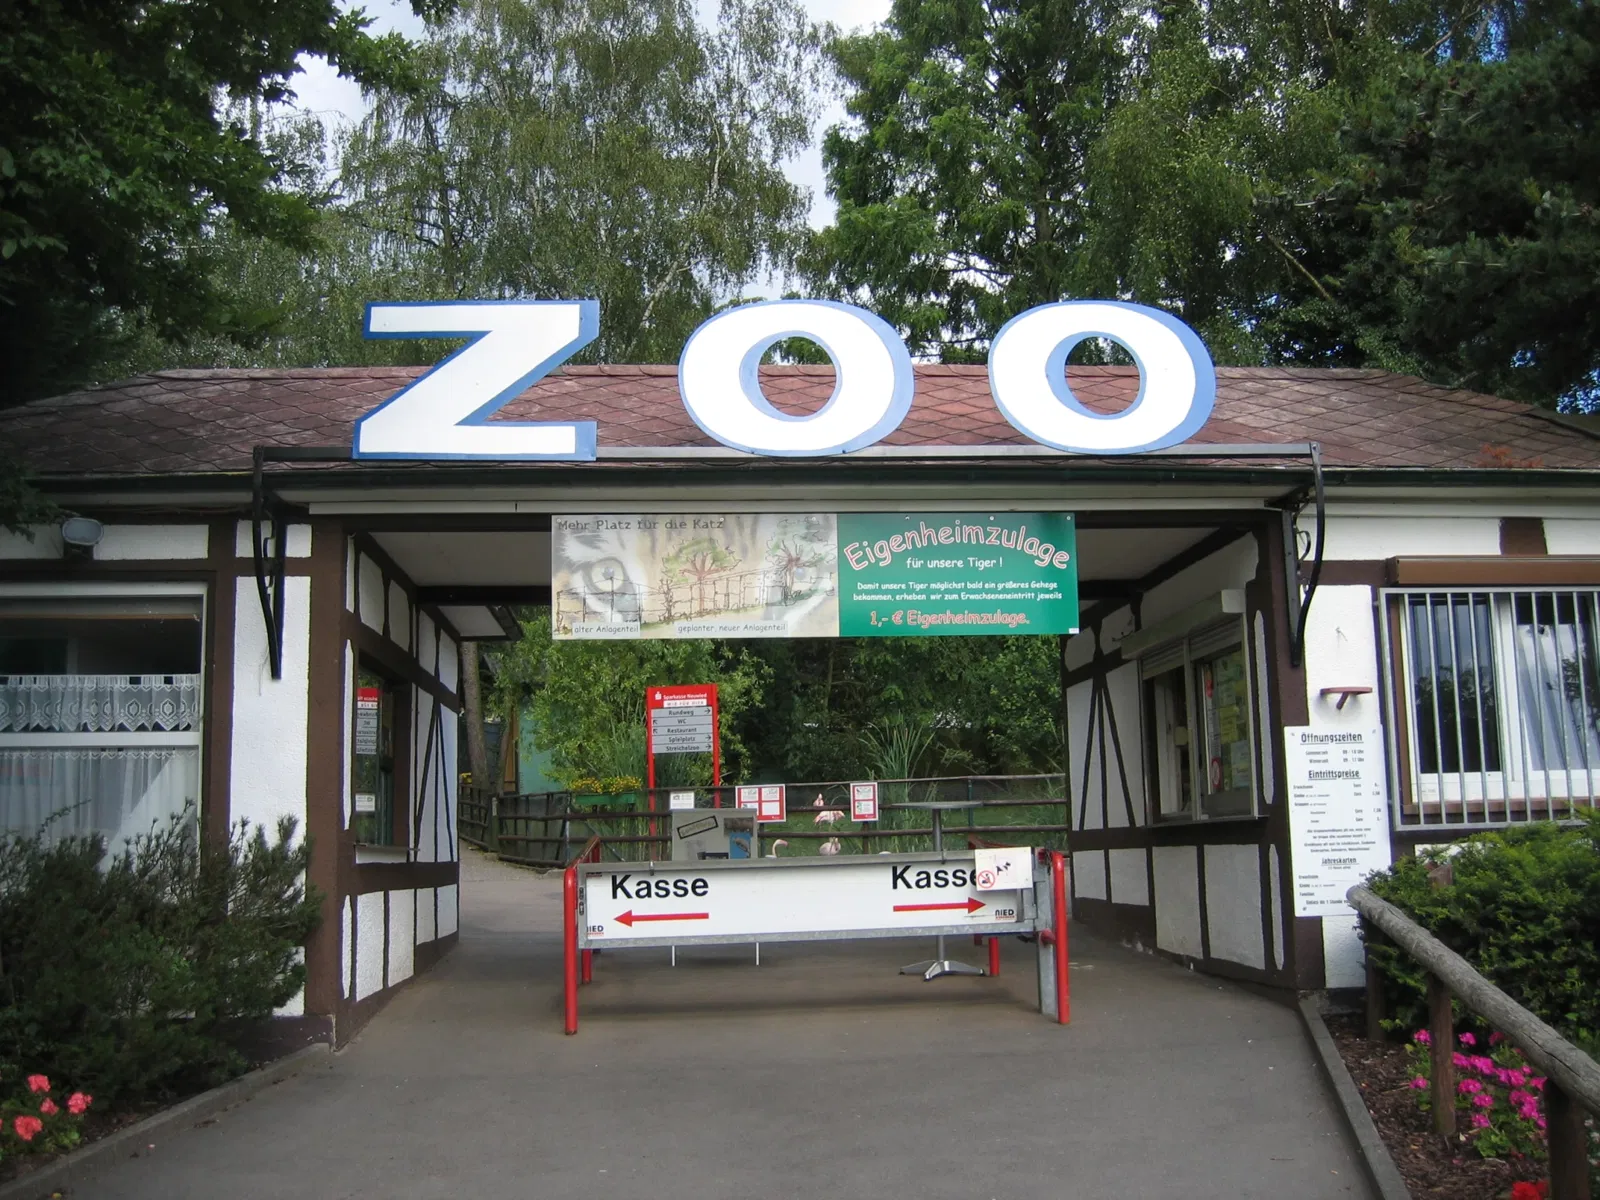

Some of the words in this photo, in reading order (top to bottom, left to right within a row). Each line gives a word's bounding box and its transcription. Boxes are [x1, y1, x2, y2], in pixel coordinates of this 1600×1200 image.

[353, 299, 1217, 462] ZOO
[558, 519, 590, 530] Mehr
[596, 519, 631, 530] Platz
[637, 518, 657, 530] für
[665, 519, 687, 530] die
[693, 519, 724, 530] Katz
[843, 520, 1070, 570] Eigenheimzulage
[906, 556, 924, 569] für
[927, 558, 964, 569] unsere
[967, 556, 997, 571] Tiger
[999, 556, 1003, 568] !
[857, 581, 879, 590] Damit
[881, 582, 906, 590] unsere
[908, 581, 928, 591] Tiger
[930, 580, 965, 591] möglichst
[967, 580, 983, 589] bald
[984, 580, 996, 589] ein
[997, 580, 1029, 590] größeres
[1030, 580, 1058, 590] Gehege
[853, 592, 894, 602] bekommen,
[895, 592, 926, 601] erheben
[930, 592, 942, 600] wir
[944, 592, 959, 600] zum
[961, 591, 1035, 600] Erwachseneneintritt
[1036, 591, 1063, 602] jeweils
[892, 609, 904, 625] €
[907, 609, 1030, 629] Eigenheimzulage.
[574, 624, 594, 633] alter
[595, 624, 639, 634] Anlagenteil
[678, 623, 718, 633] geplanter,
[719, 624, 741, 632] neuer
[743, 623, 786, 633] Anlagenteil
[1301, 732, 1363, 744] Öffnungszeiten
[1308, 769, 1360, 779] Eintrittspreise
[1322, 857, 1357, 865] Jahreskarten
[611, 874, 709, 900] Kasse
[587, 925, 604, 933] IED
